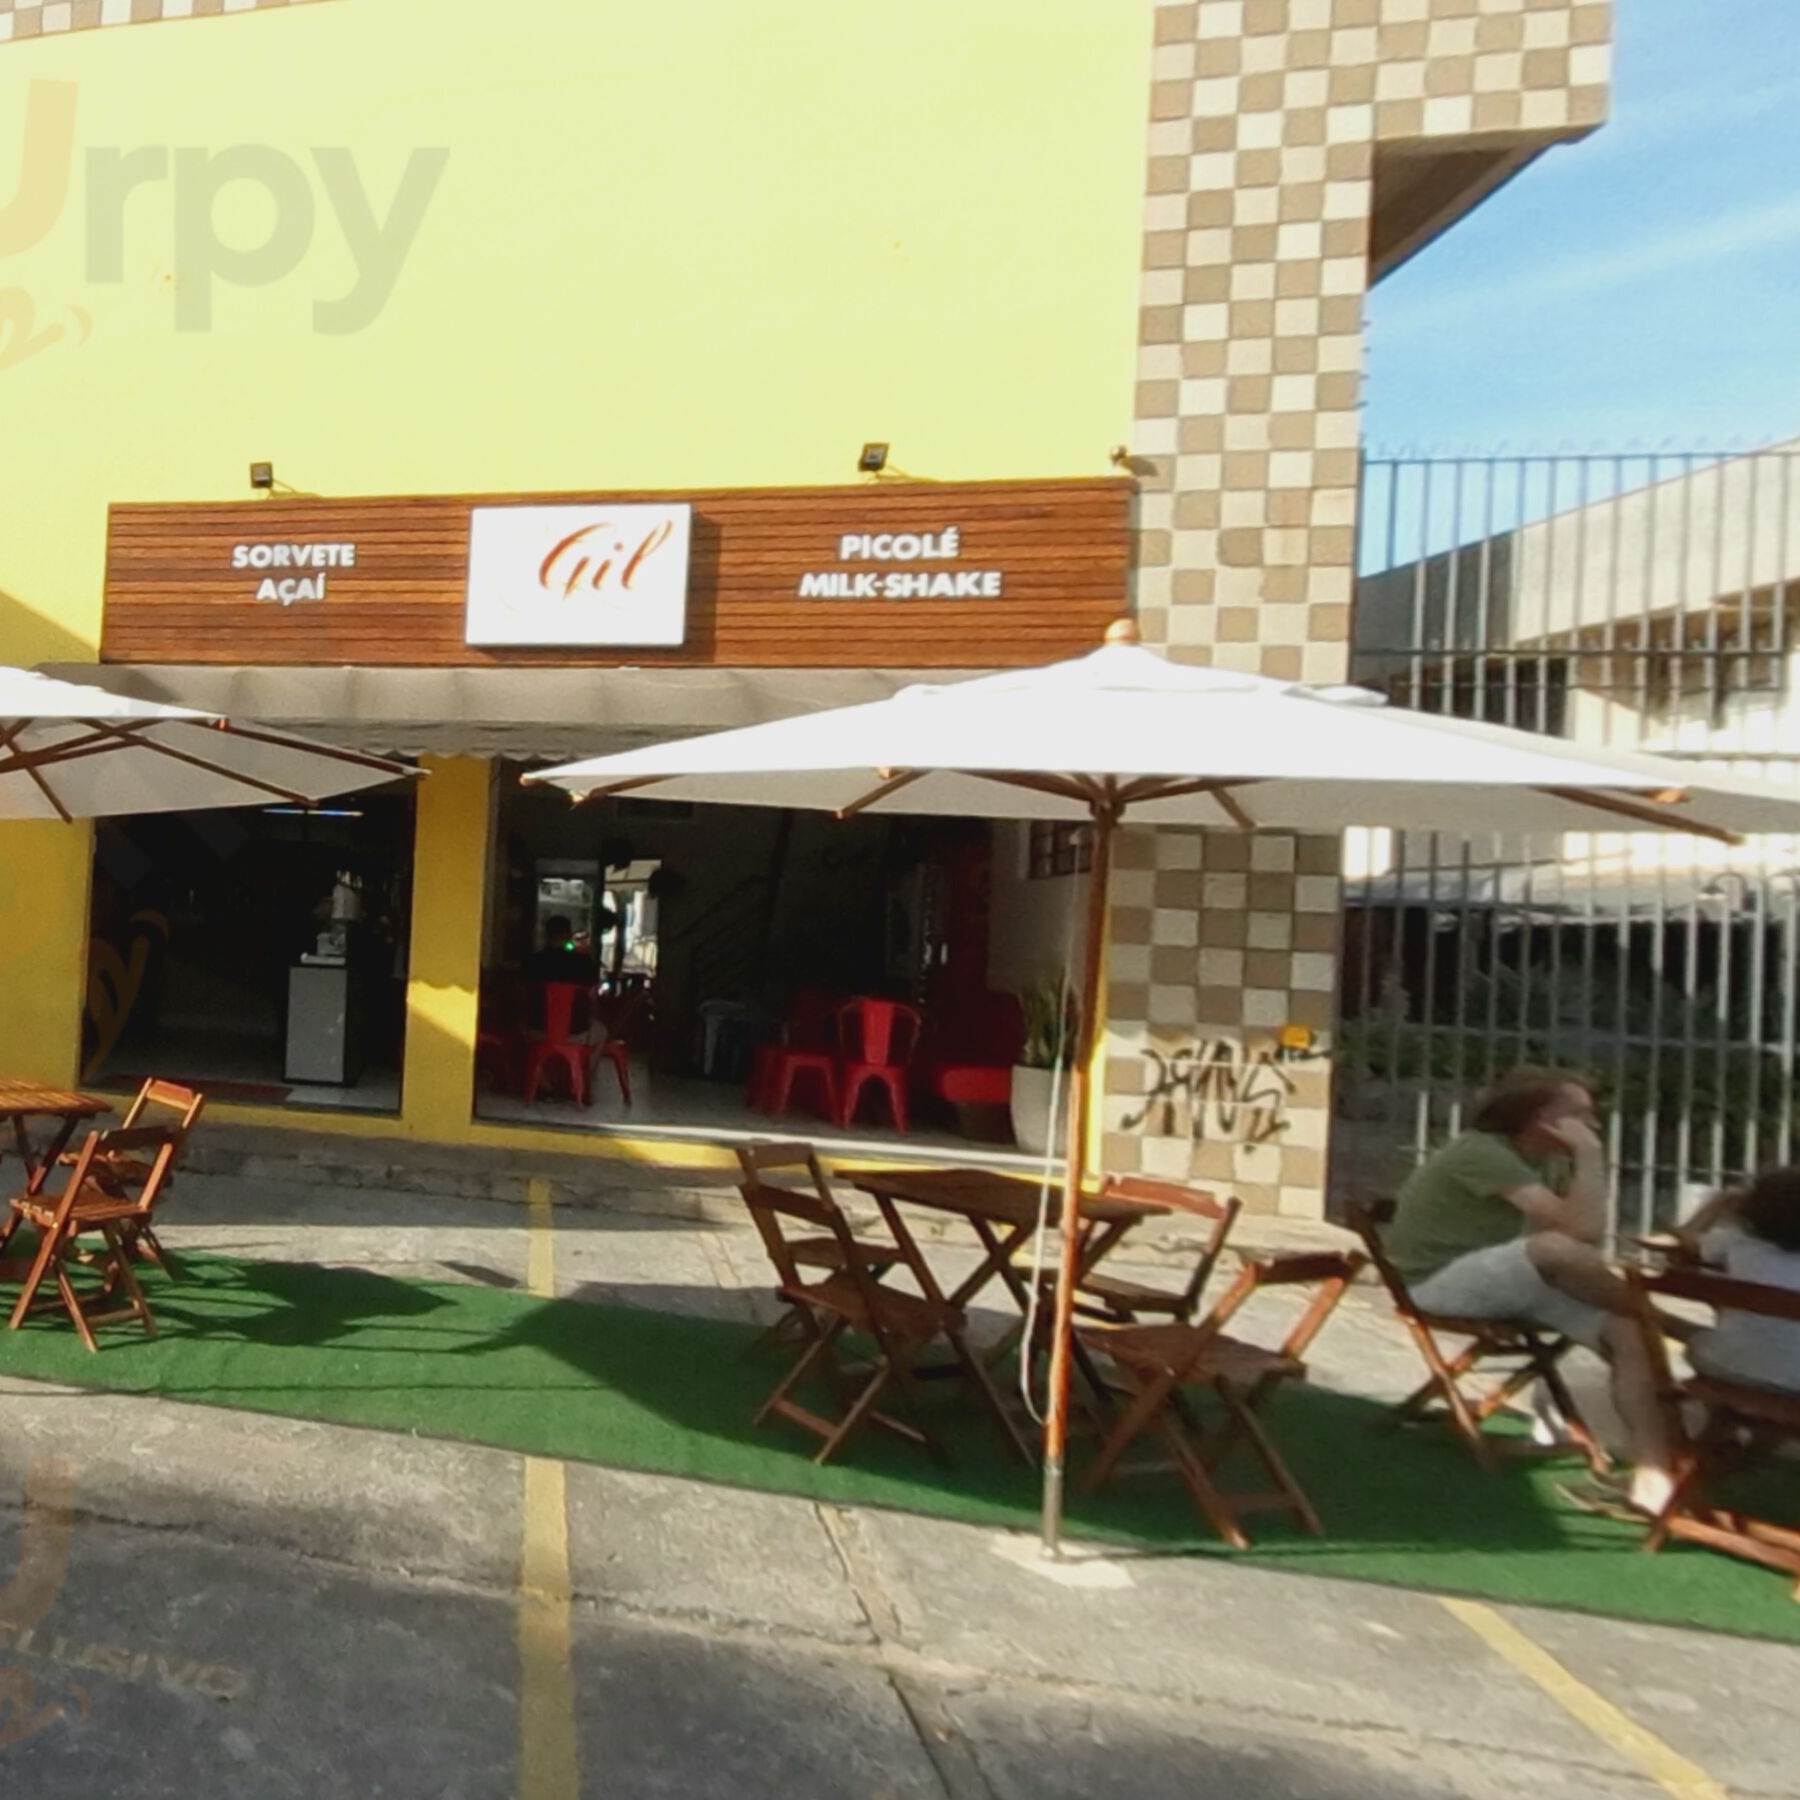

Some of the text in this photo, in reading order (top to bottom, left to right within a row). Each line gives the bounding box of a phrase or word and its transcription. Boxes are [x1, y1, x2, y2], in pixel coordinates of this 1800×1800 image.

[232, 543, 356, 569] SORVETE
[539, 519, 675, 600] Gil
[839, 526, 959, 560] PICOLÉ
[256, 571, 327, 606] AÇAÍ
[799, 570, 1002, 598] MILK-SHAKE
